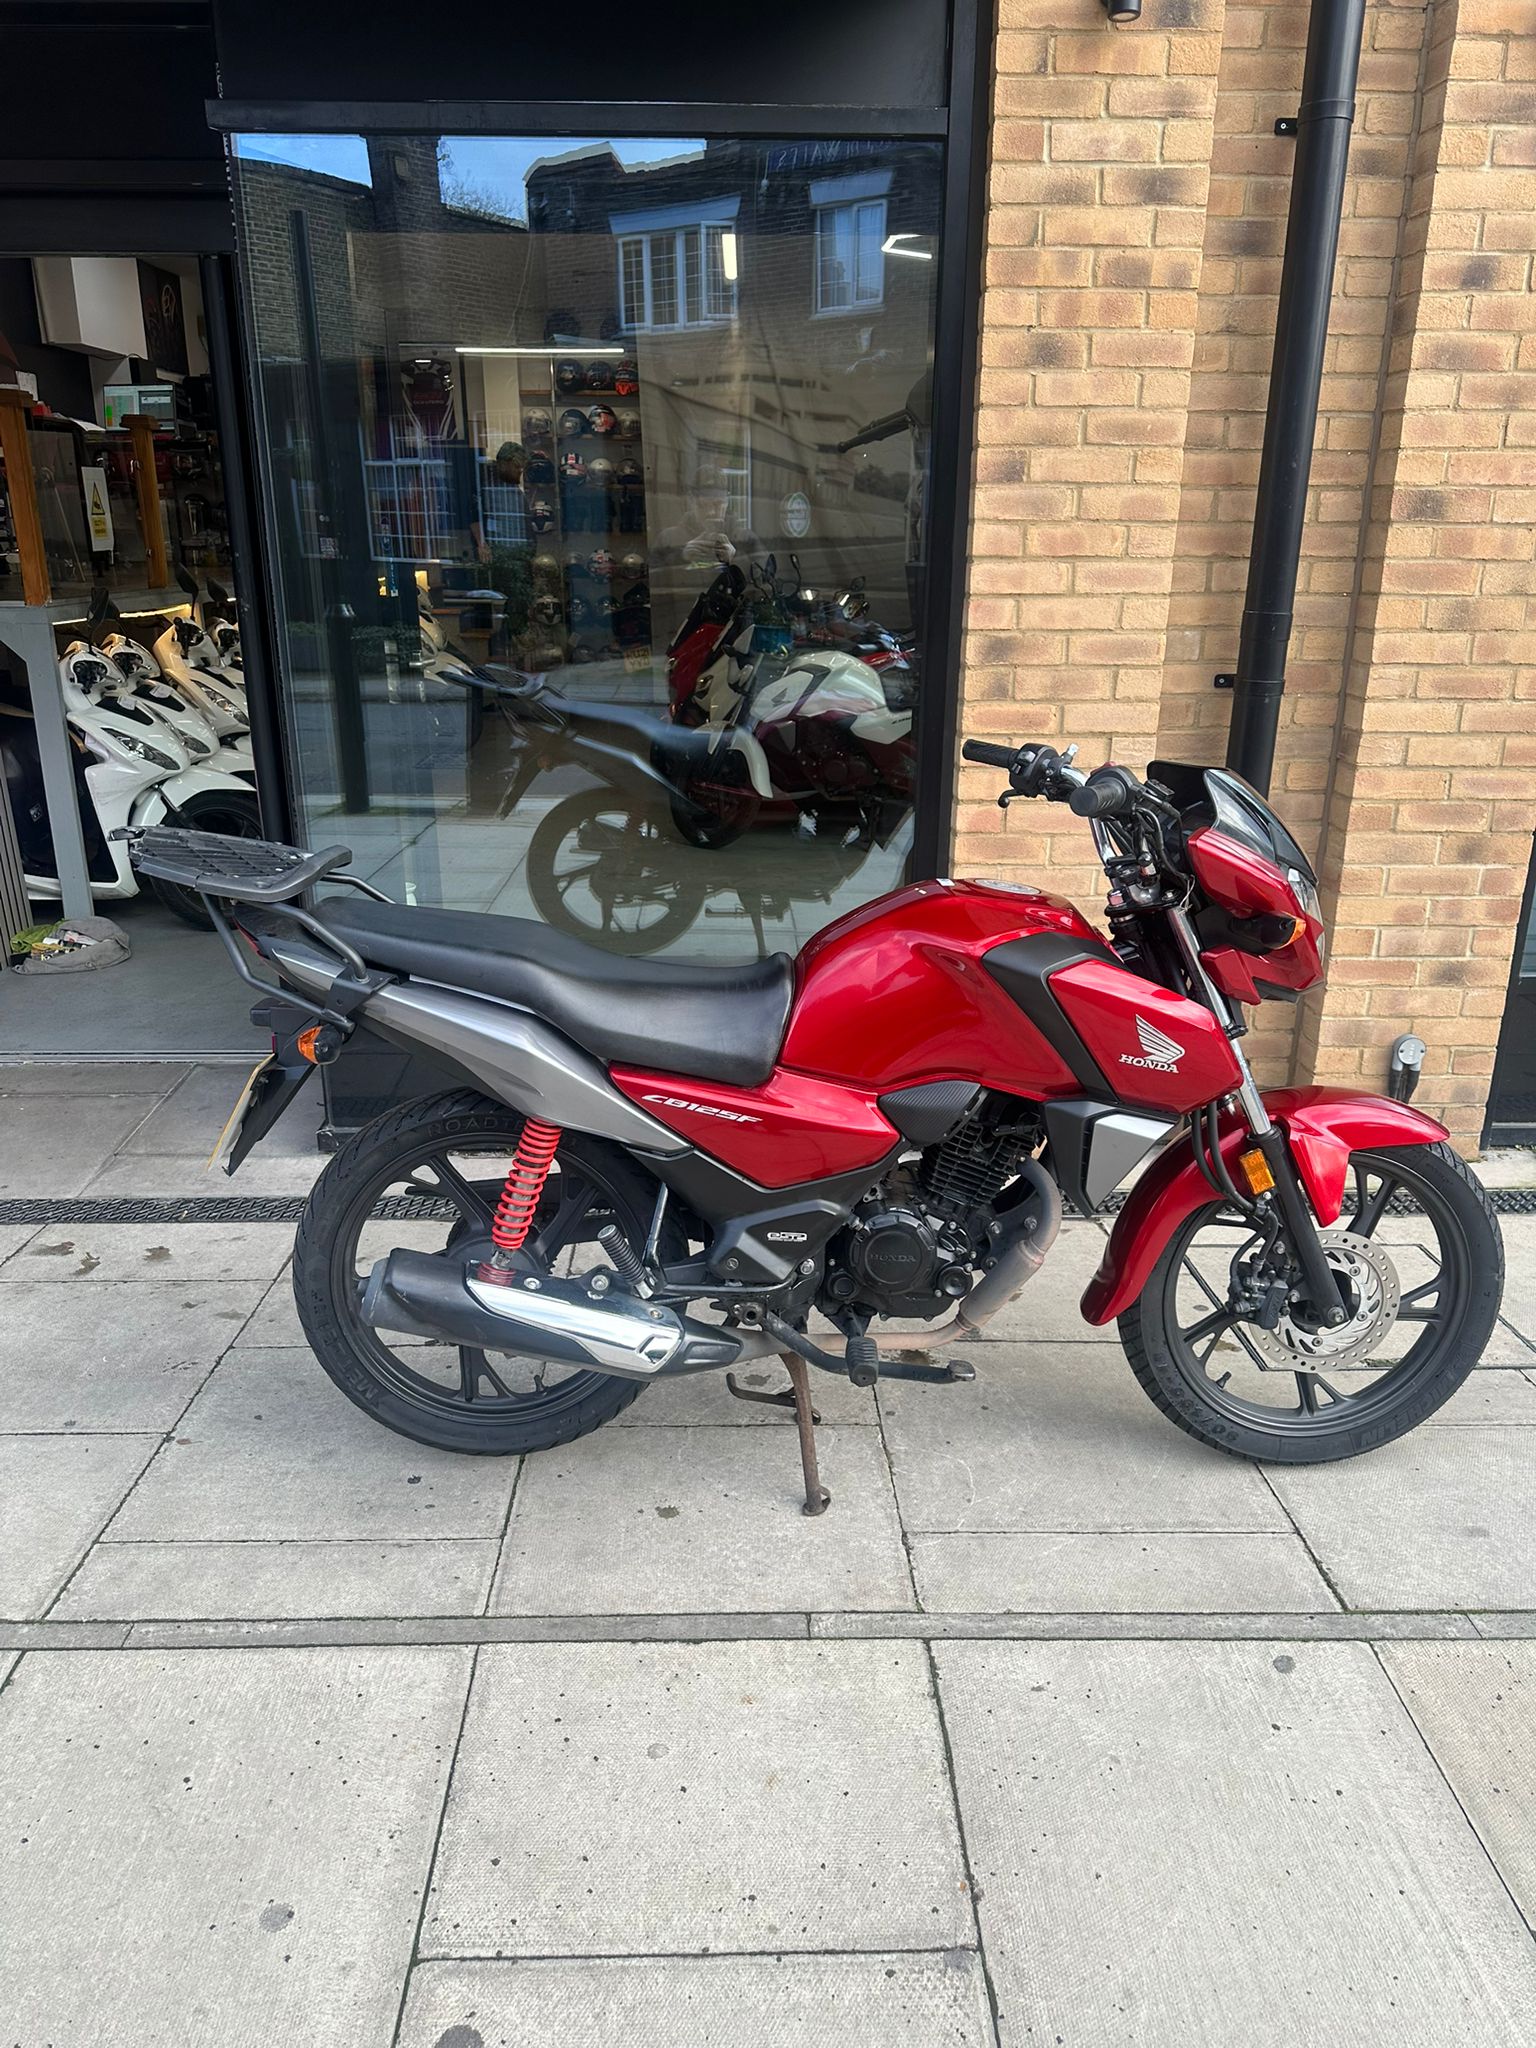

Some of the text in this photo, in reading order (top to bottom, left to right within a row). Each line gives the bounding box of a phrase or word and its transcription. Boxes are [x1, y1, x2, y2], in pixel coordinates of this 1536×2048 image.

[1118, 1053, 1179, 1074] HONDA
[641, 1094, 763, 1123] CB125F
[870, 1253, 917, 1265] HONDA
